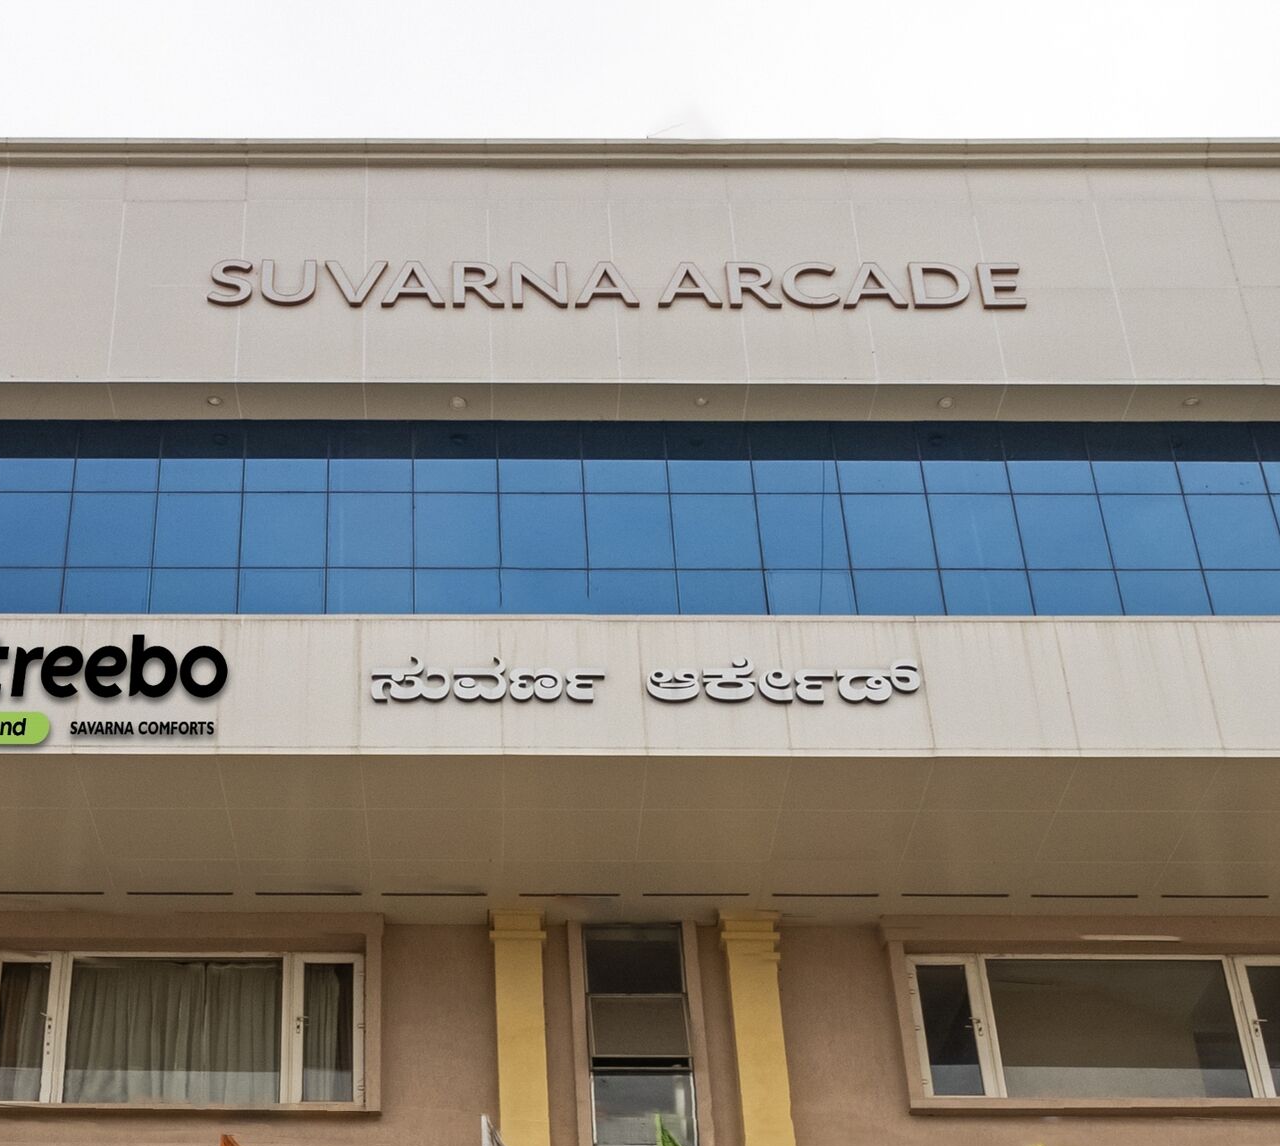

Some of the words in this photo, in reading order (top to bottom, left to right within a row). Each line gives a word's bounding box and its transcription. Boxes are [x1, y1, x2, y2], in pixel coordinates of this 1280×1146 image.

[206, 258, 641, 309] SUVARNA
[657, 260, 1027, 310] ARCADE
[69, 720, 135, 736] SAVARNA
[137, 720, 216, 736] COMFORTS
